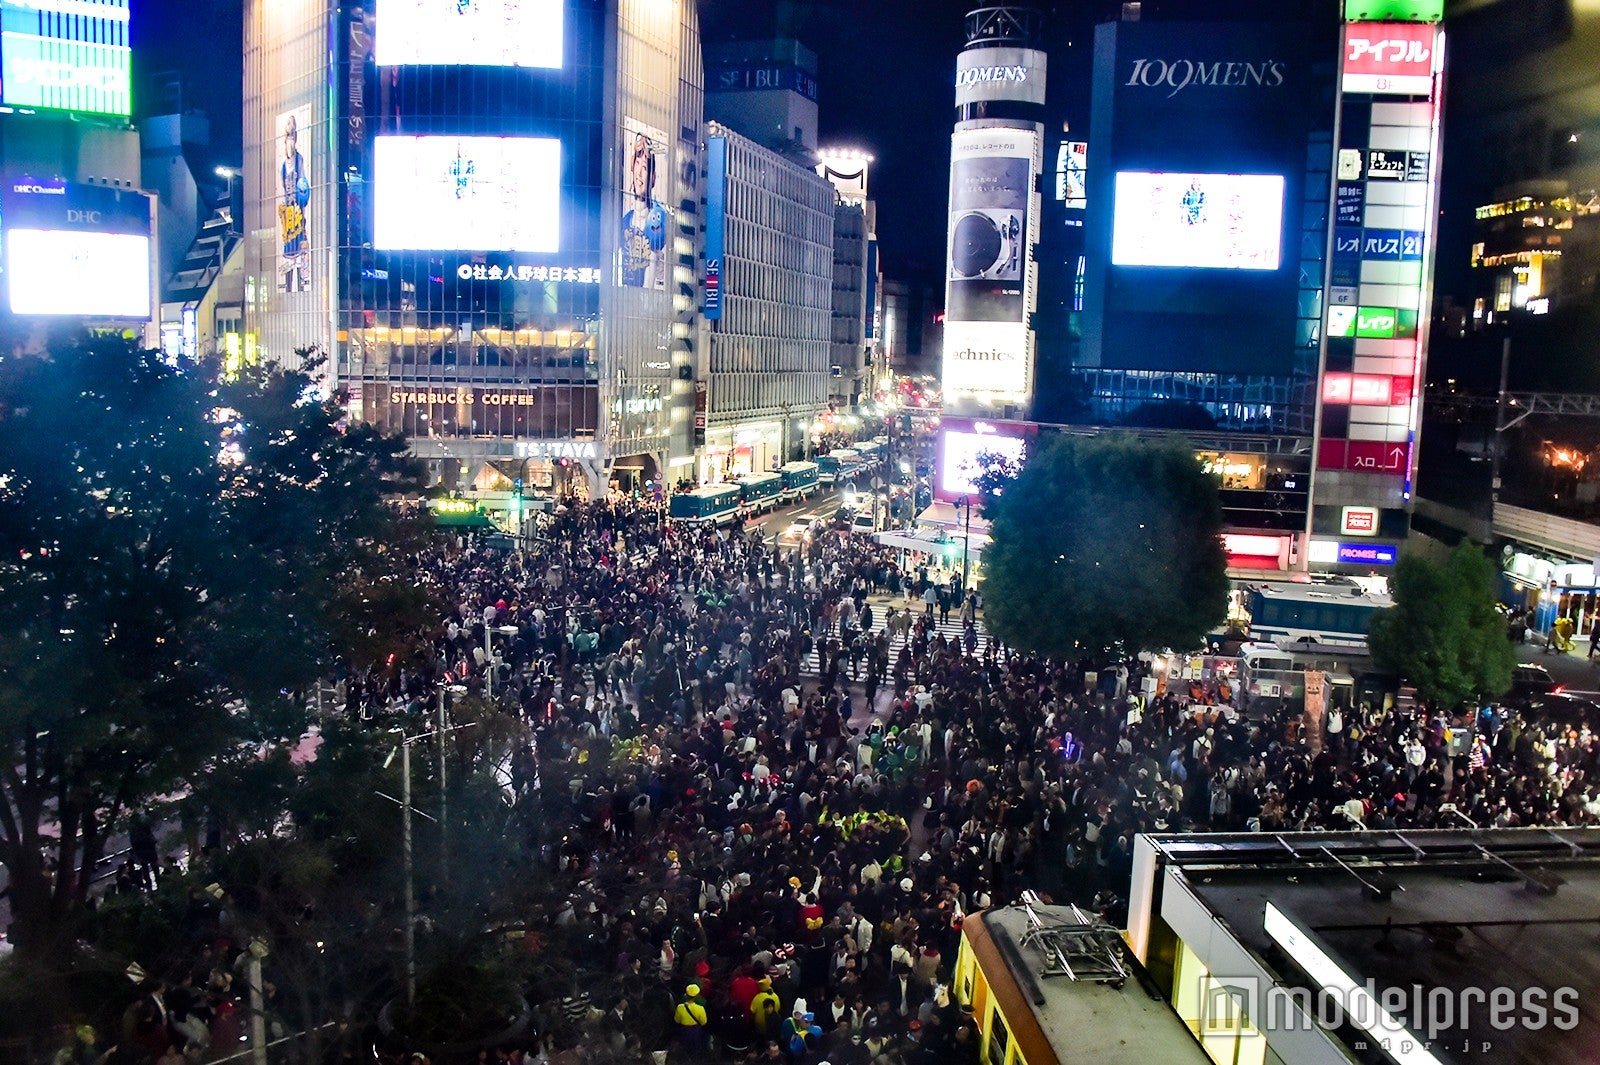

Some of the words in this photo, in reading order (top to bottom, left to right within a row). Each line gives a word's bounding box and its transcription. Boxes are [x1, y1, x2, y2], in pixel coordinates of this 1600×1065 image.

[1348, 38, 1430, 62] アイフル
[67, 209, 101, 223] DHC
[706, 259, 719, 308] SEIBU
[1357, 315, 1394, 330] レイク
[391, 392, 475, 404] STARBUCKS
[481, 394, 534, 406] COFFEE
[1354, 456, 1376, 467] 入口
[1340, 549, 1377, 559] PROMISE
